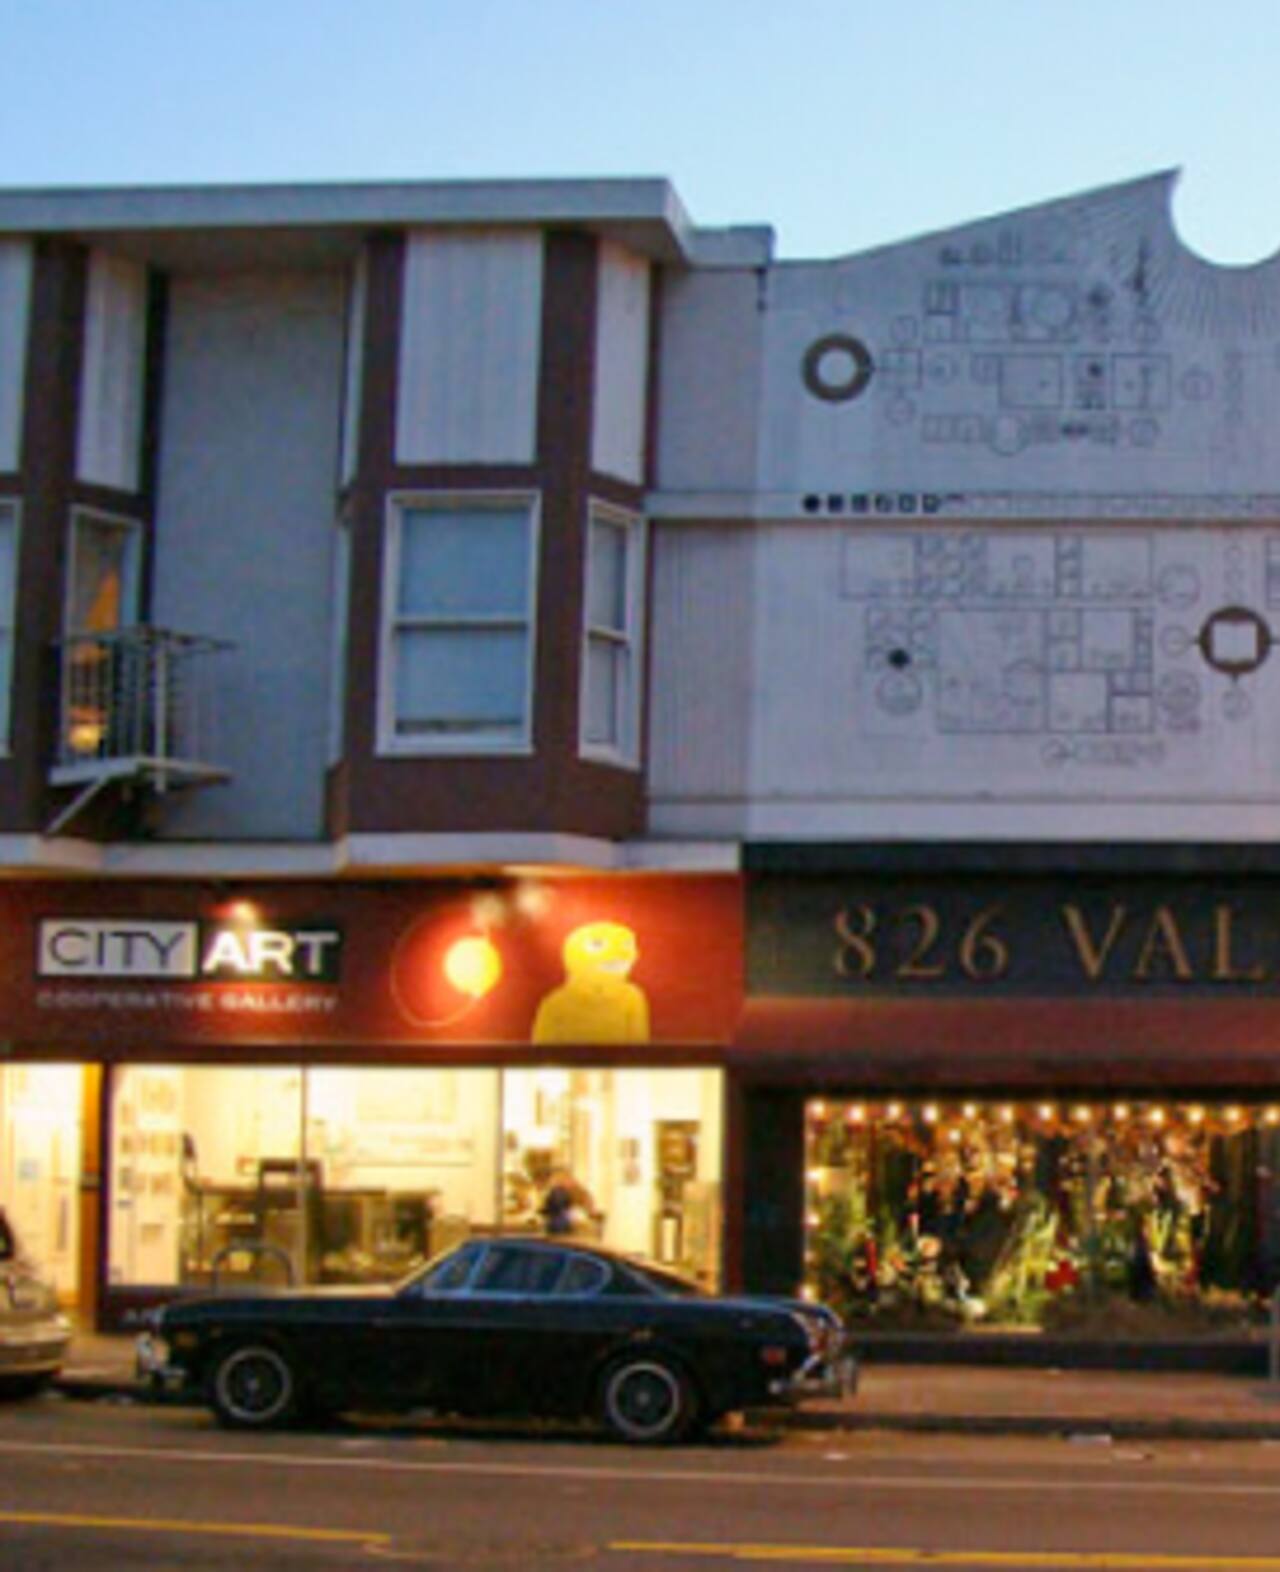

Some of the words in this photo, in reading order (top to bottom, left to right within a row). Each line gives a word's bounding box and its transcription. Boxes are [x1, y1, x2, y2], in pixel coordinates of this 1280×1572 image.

[50, 928, 185, 967] CITY
[201, 930, 340, 975] ART
[833, 905, 1010, 979] 826
[36, 990, 214, 1012] COOPERATIVE
[220, 992, 338, 1014] GALLERY
